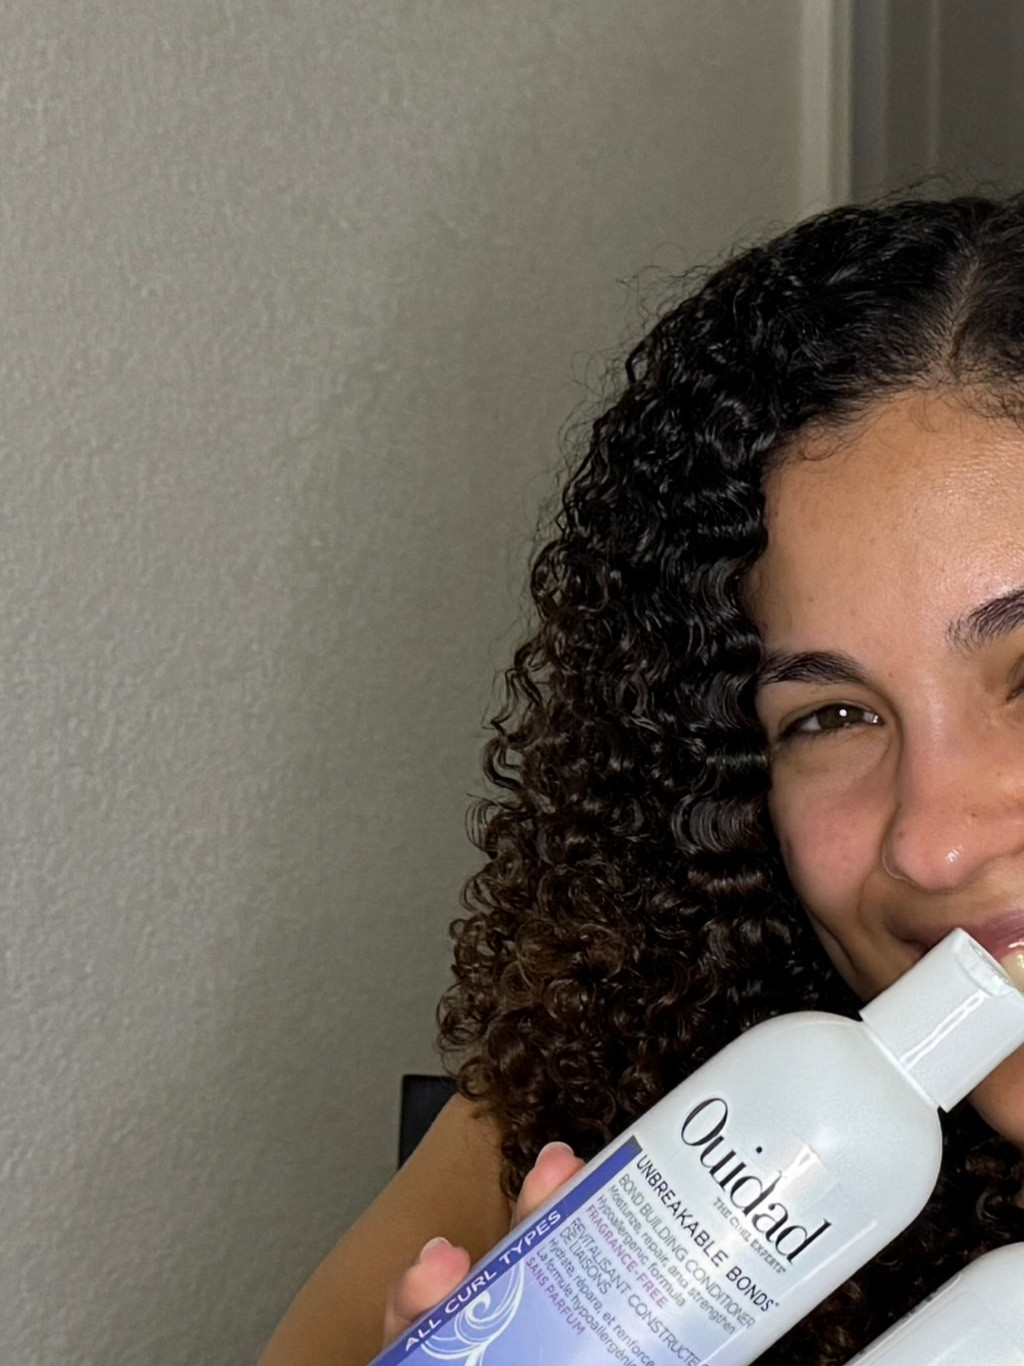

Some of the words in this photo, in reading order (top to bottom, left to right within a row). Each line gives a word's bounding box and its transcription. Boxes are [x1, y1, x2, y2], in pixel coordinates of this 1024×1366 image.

[636, 1154, 728, 1267] UNBREAKABLE
[682, 1097, 831, 1264] Ouidad
[713, 1197, 732, 1218] THE
[407, 1319, 442, 1351] ALL
[446, 1272, 497, 1312] CURL
[498, 1210, 560, 1265] TYPES
[536, 1247, 548, 1262] La
[547, 1237, 575, 1277] Hydrate,
[601, 1310, 617, 1325] et
[559, 1226, 574, 1244] DE
[568, 1239, 612, 1295] LIAISONS
[569, 1216, 631, 1296] REVITALISANT
[585, 1203, 668, 1308] FRAGRANCE-FREE
[595, 1194, 650, 1265] Hypoallergenic
[647, 1261, 687, 1307] formula
[617, 1173, 645, 1207] BOND
[639, 1202, 688, 1261] BUILDING
[686, 1260, 756, 1328] CONDITIONER
[525, 1256, 549, 1286] SANS
[544, 1284, 586, 1335] PARFUM
[687, 1286, 736, 1334] strengthen
